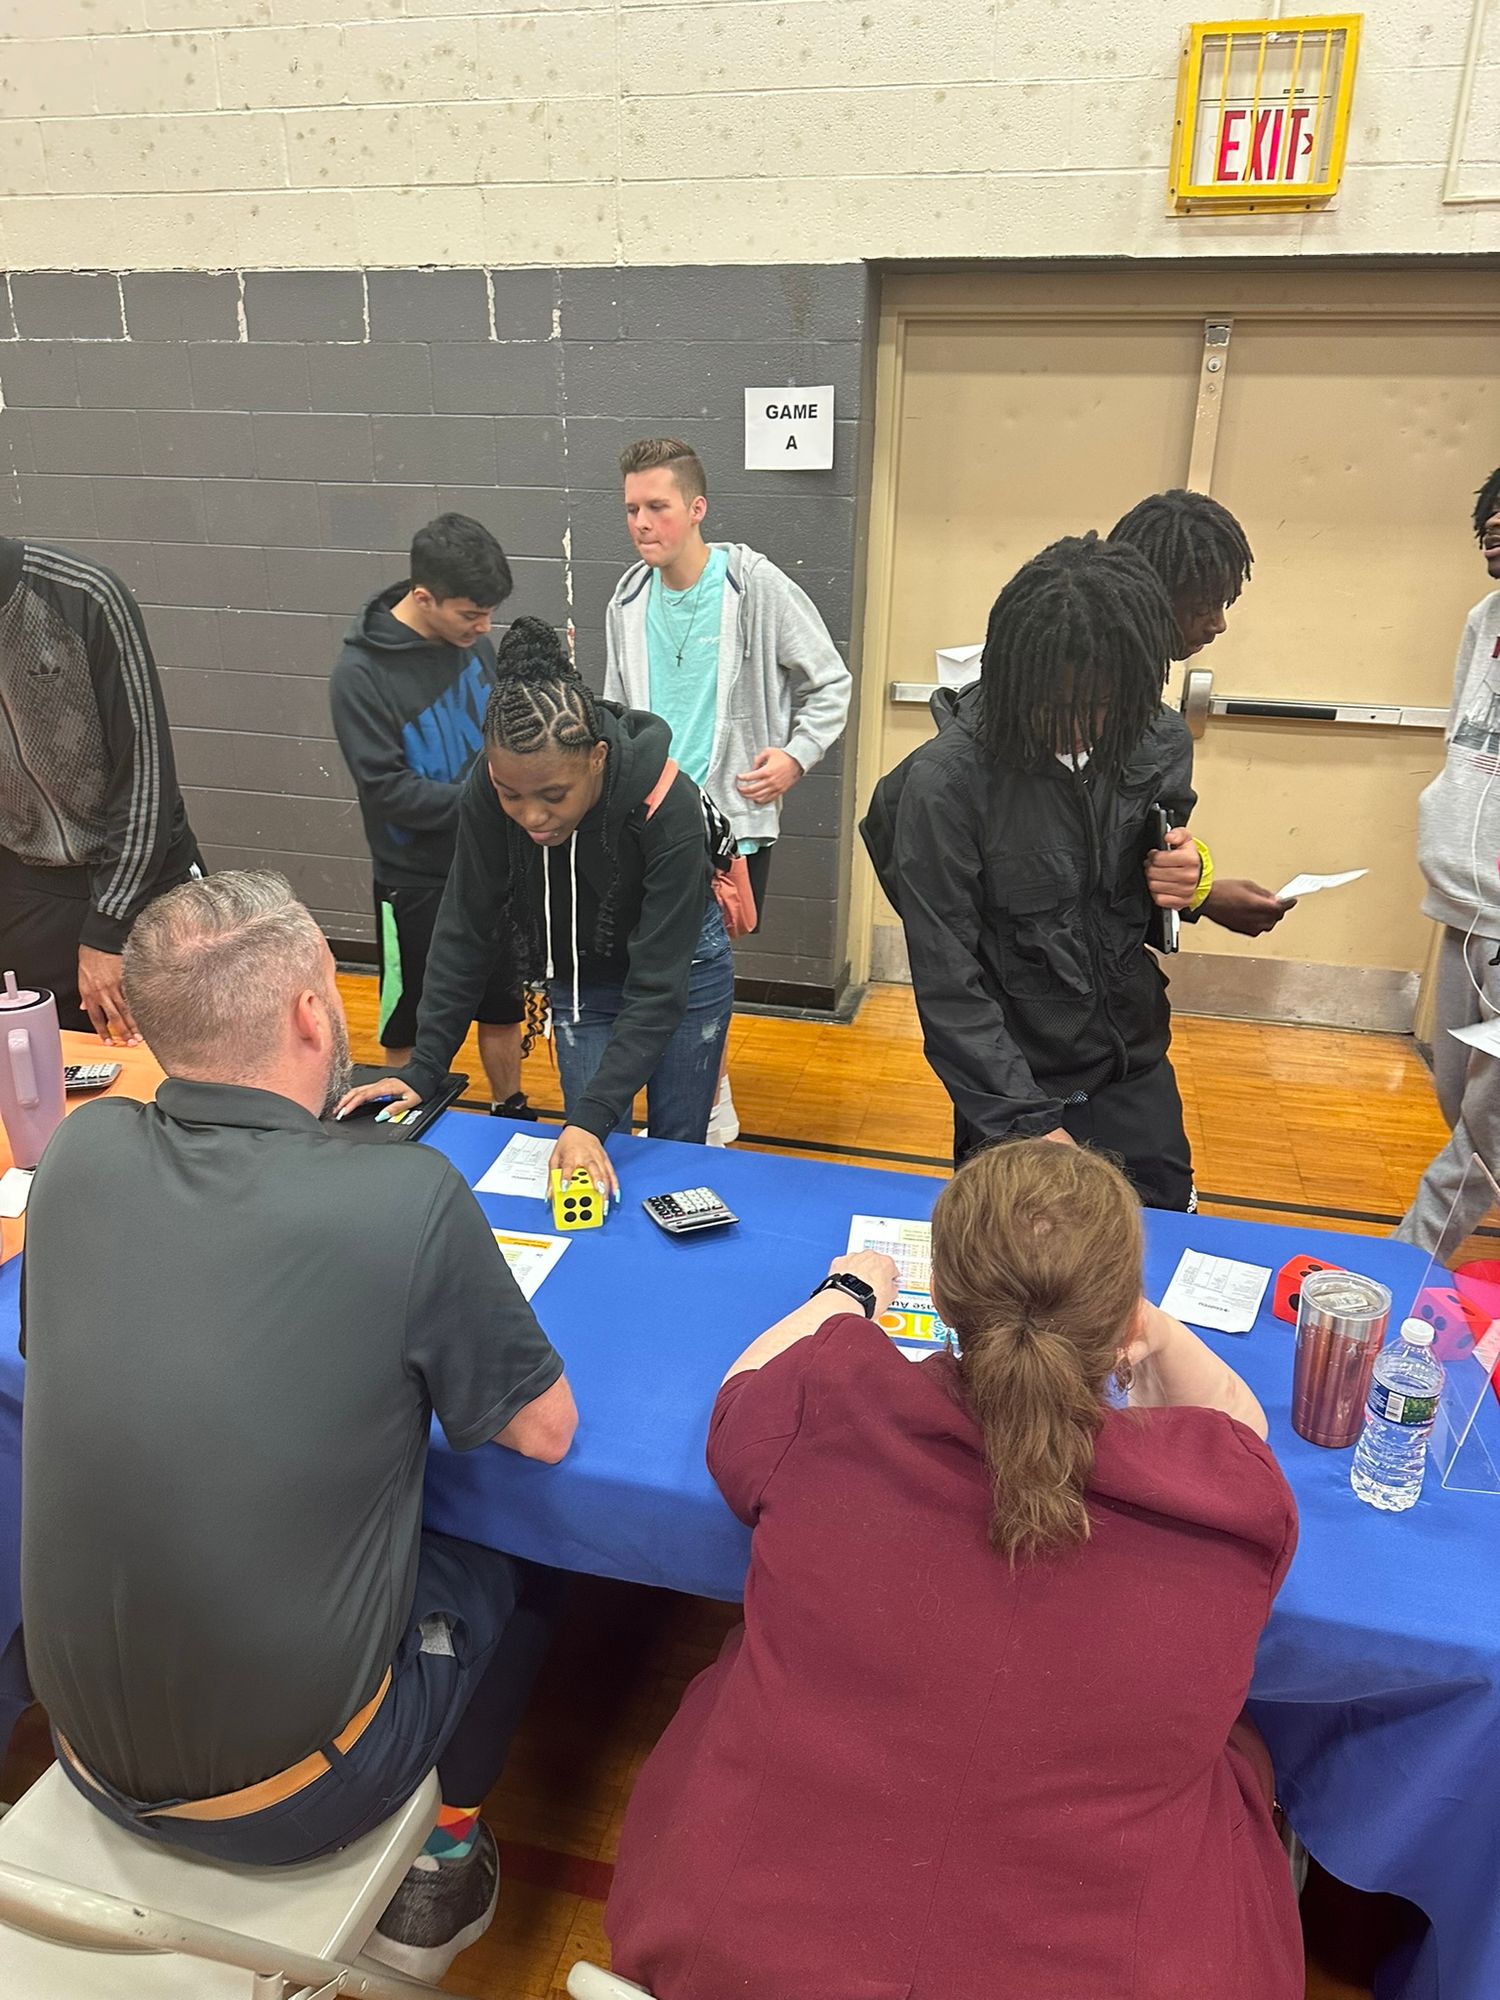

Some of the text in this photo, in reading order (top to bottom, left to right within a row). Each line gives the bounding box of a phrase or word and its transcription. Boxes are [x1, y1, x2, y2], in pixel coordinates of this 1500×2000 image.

[1216, 108, 1310, 181] EXIT
[765, 404, 818, 419] GAME
[785, 435, 798, 450] A
